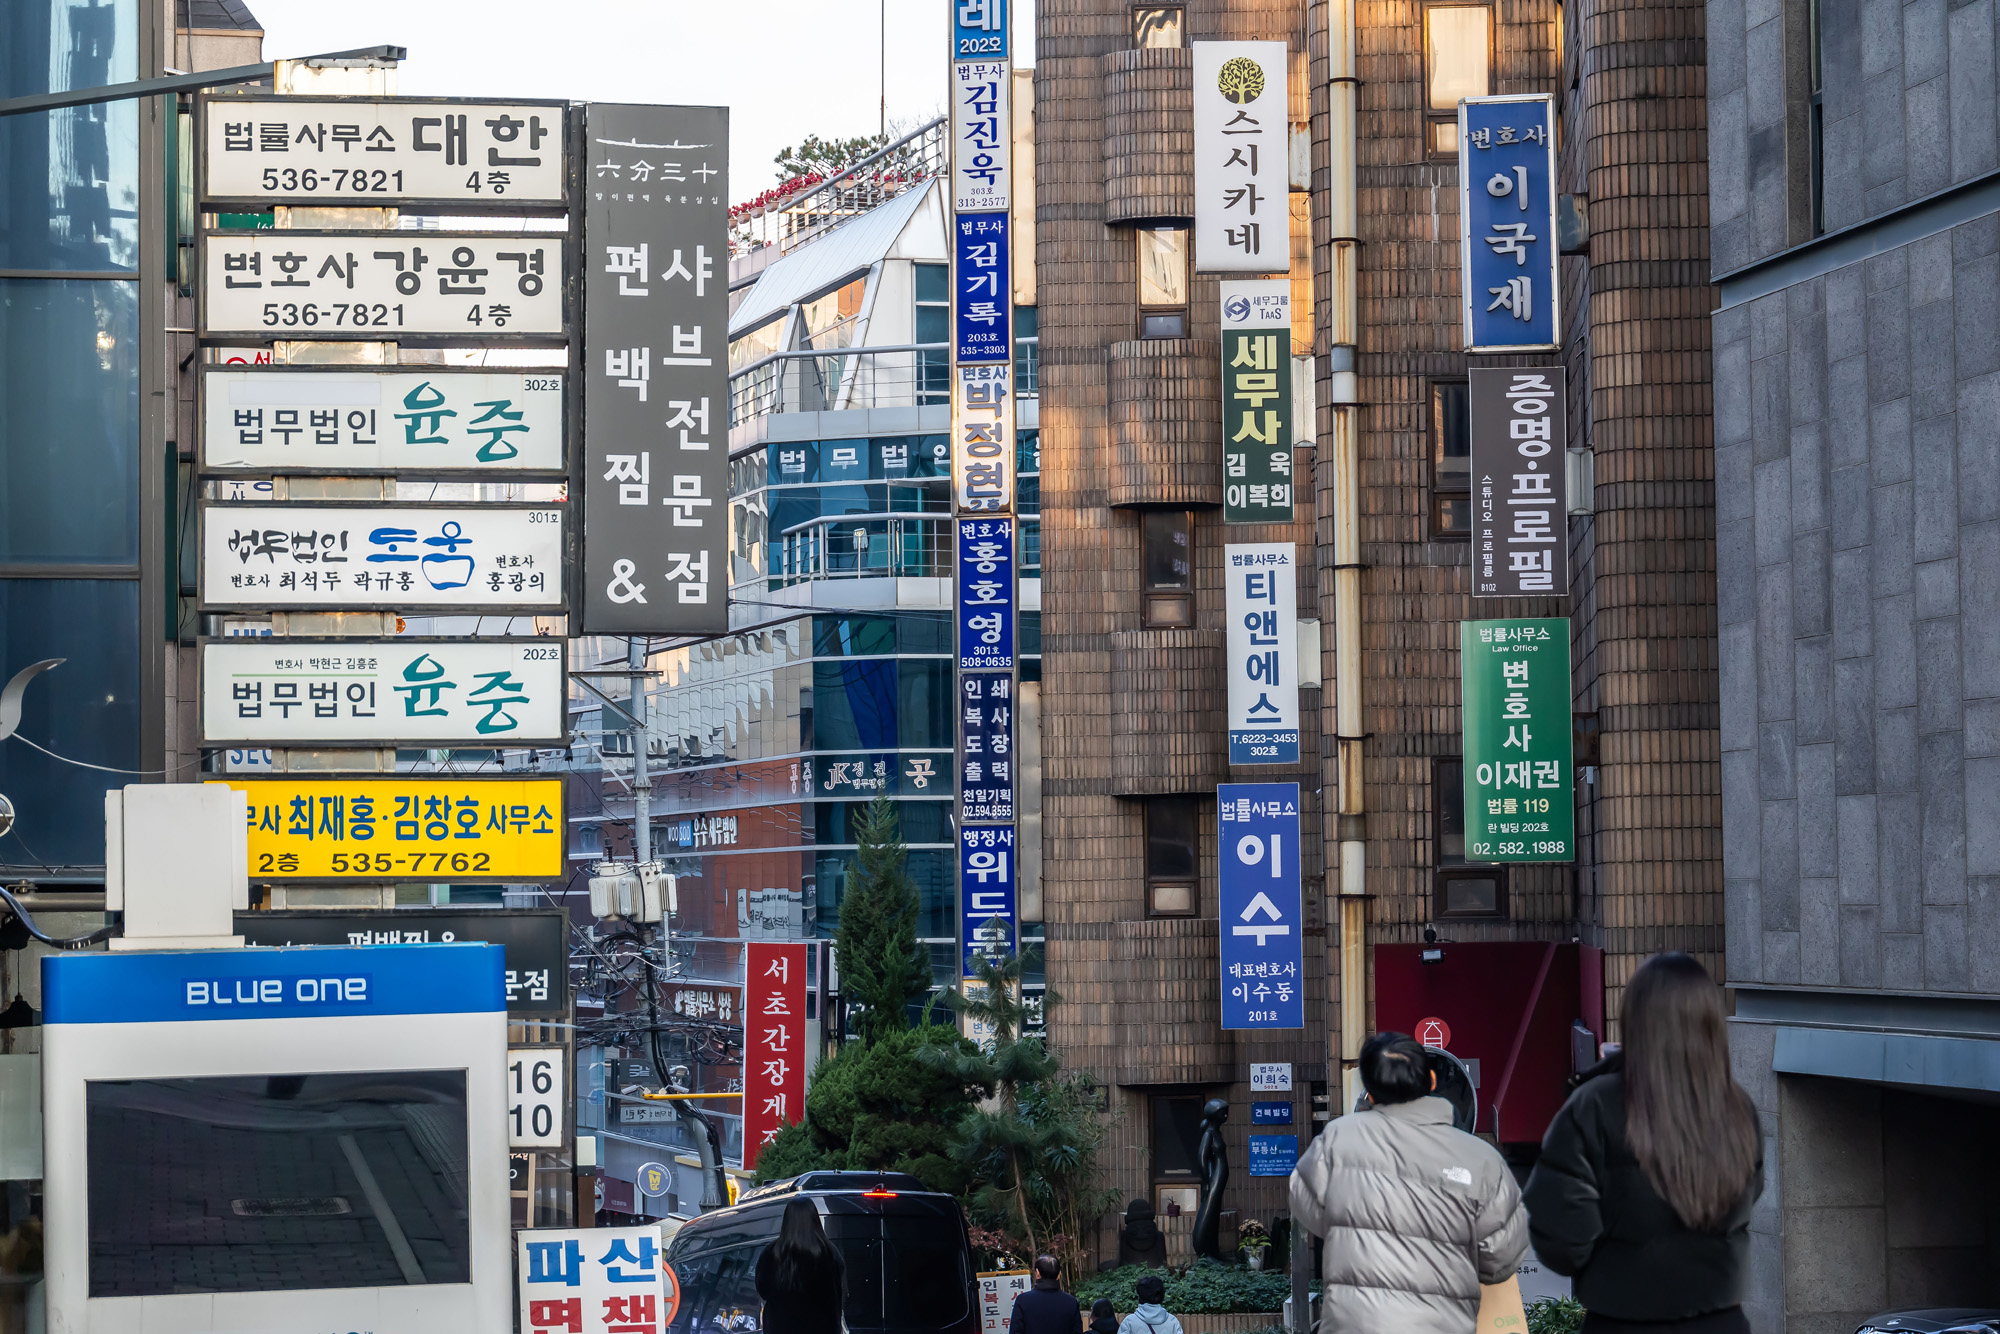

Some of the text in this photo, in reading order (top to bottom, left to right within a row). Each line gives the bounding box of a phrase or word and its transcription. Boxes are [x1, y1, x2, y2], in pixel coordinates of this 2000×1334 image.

[960, 36, 1002, 54] 202호
[958, 64, 1004, 80] 법무사
[224, 114, 548, 167] 법률사무소 대한
[962, 82, 1003, 186] 김진욱
[1470, 124, 1547, 150] 변호사
[596, 158, 718, 184] 六分三十
[262, 168, 512, 195] 536-7821 4층
[971, 187, 994, 195] 303호
[1220, 110, 1265, 256] 스시카네
[958, 197, 1006, 208] 313-2577
[961, 220, 1004, 236] 법무사
[1484, 165, 1537, 322] 이국재
[224, 246, 545, 297] 변호사 강윤경
[963, 241, 1003, 327] 김기록
[1252, 295, 1288, 306] 세무그룹
[262, 303, 512, 327] 536-7821 4층
[967, 332, 998, 342] 203호
[960, 346, 1006, 356] 535-3303
[962, 366, 1008, 381] 변호사
[524, 379, 561, 392] 302호
[1230, 335, 1282, 445] 세무사
[234, 380, 531, 464] 법무법인 윤중
[603, 244, 650, 604] 편백찜 &
[662, 244, 713, 604] 샤브전문점
[964, 382, 1007, 498] 박정현
[1227, 484, 1291, 508] 이복희
[1481, 474, 1493, 523] 스튜디오
[528, 512, 559, 524] 301호
[961, 522, 1012, 540] 변호사
[228, 520, 475, 590] 법무법인 도움
[496, 554, 534, 568] 변호사
[1232, 554, 1289, 566] 법률사무소
[230, 570, 415, 592] 변호사 최석두 곽규홍
[486, 571, 544, 592] 홍광의
[1480, 584, 1497, 592] B102
[964, 542, 1008, 644] 홍호영
[1479, 627, 1550, 643] 법률사무소
[522, 648, 560, 662] 202호
[973, 646, 1000, 656] 301호
[1244, 570, 1282, 724] 티앤에스
[1492, 644, 1538, 653] Law Office
[274, 656, 378, 671] 변호사 박현근 김흥준
[961, 656, 1012, 668] 508-0635
[232, 652, 530, 735] 법무법인 윤중
[965, 679, 1009, 700] 인쇄
[1502, 660, 1532, 752] 변호사
[965, 706, 1010, 727] 복사
[965, 734, 1010, 754] 도장
[1232, 733, 1298, 745] T.6223-3453
[1250, 746, 1279, 756] 302호
[965, 762, 1009, 782] 출력
[1476, 760, 1560, 790] 이재권
[963, 788, 1012, 802] 천일기획
[963, 805, 1012, 817] 02.594.3555
[1222, 798, 1297, 822] 법률사무소
[1487, 798, 1550, 815] 법률 119
[486, 805, 554, 835] 사무소
[1488, 822, 1550, 834] 란 빌딩 202호
[963, 830, 1014, 848] 행정사
[1473, 841, 1566, 856] 02.582.1988
[258, 852, 491, 873] 2층 535-7762
[1232, 834, 1290, 946] 이수
[1228, 961, 1297, 978] 대표변호사
[1232, 982, 1294, 1004] 이수동
[1248, 1010, 1278, 1022] 201호
[1253, 1074, 1289, 1084] 이희숙
[526, 1236, 660, 1287] 파산
[983, 1278, 1024, 1292] 인쇄
